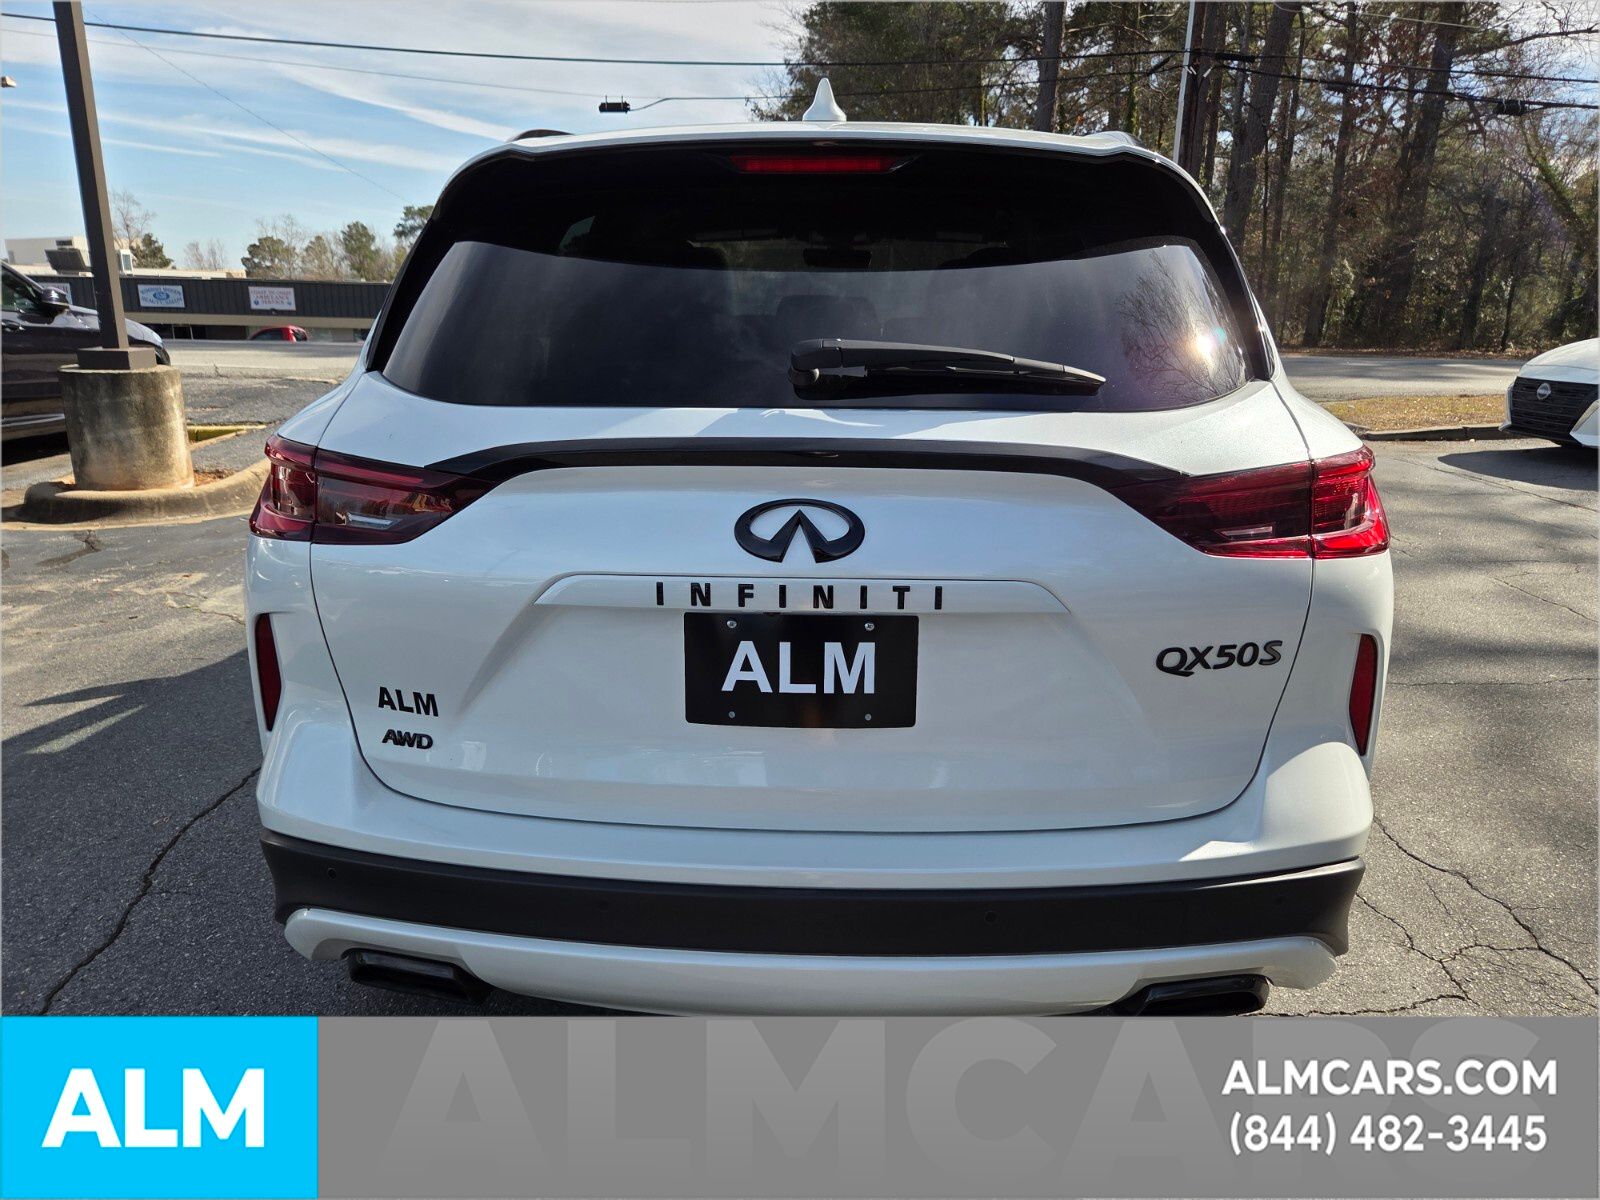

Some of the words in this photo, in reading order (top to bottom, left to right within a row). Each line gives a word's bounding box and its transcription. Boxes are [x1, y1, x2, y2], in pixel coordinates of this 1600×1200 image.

[656, 581, 943, 610] INFINITI
[721, 640, 876, 694] ALM
[1155, 640, 1283, 677] QX50S
[378, 687, 438, 717] ALM
[382, 728, 433, 750] AWD
